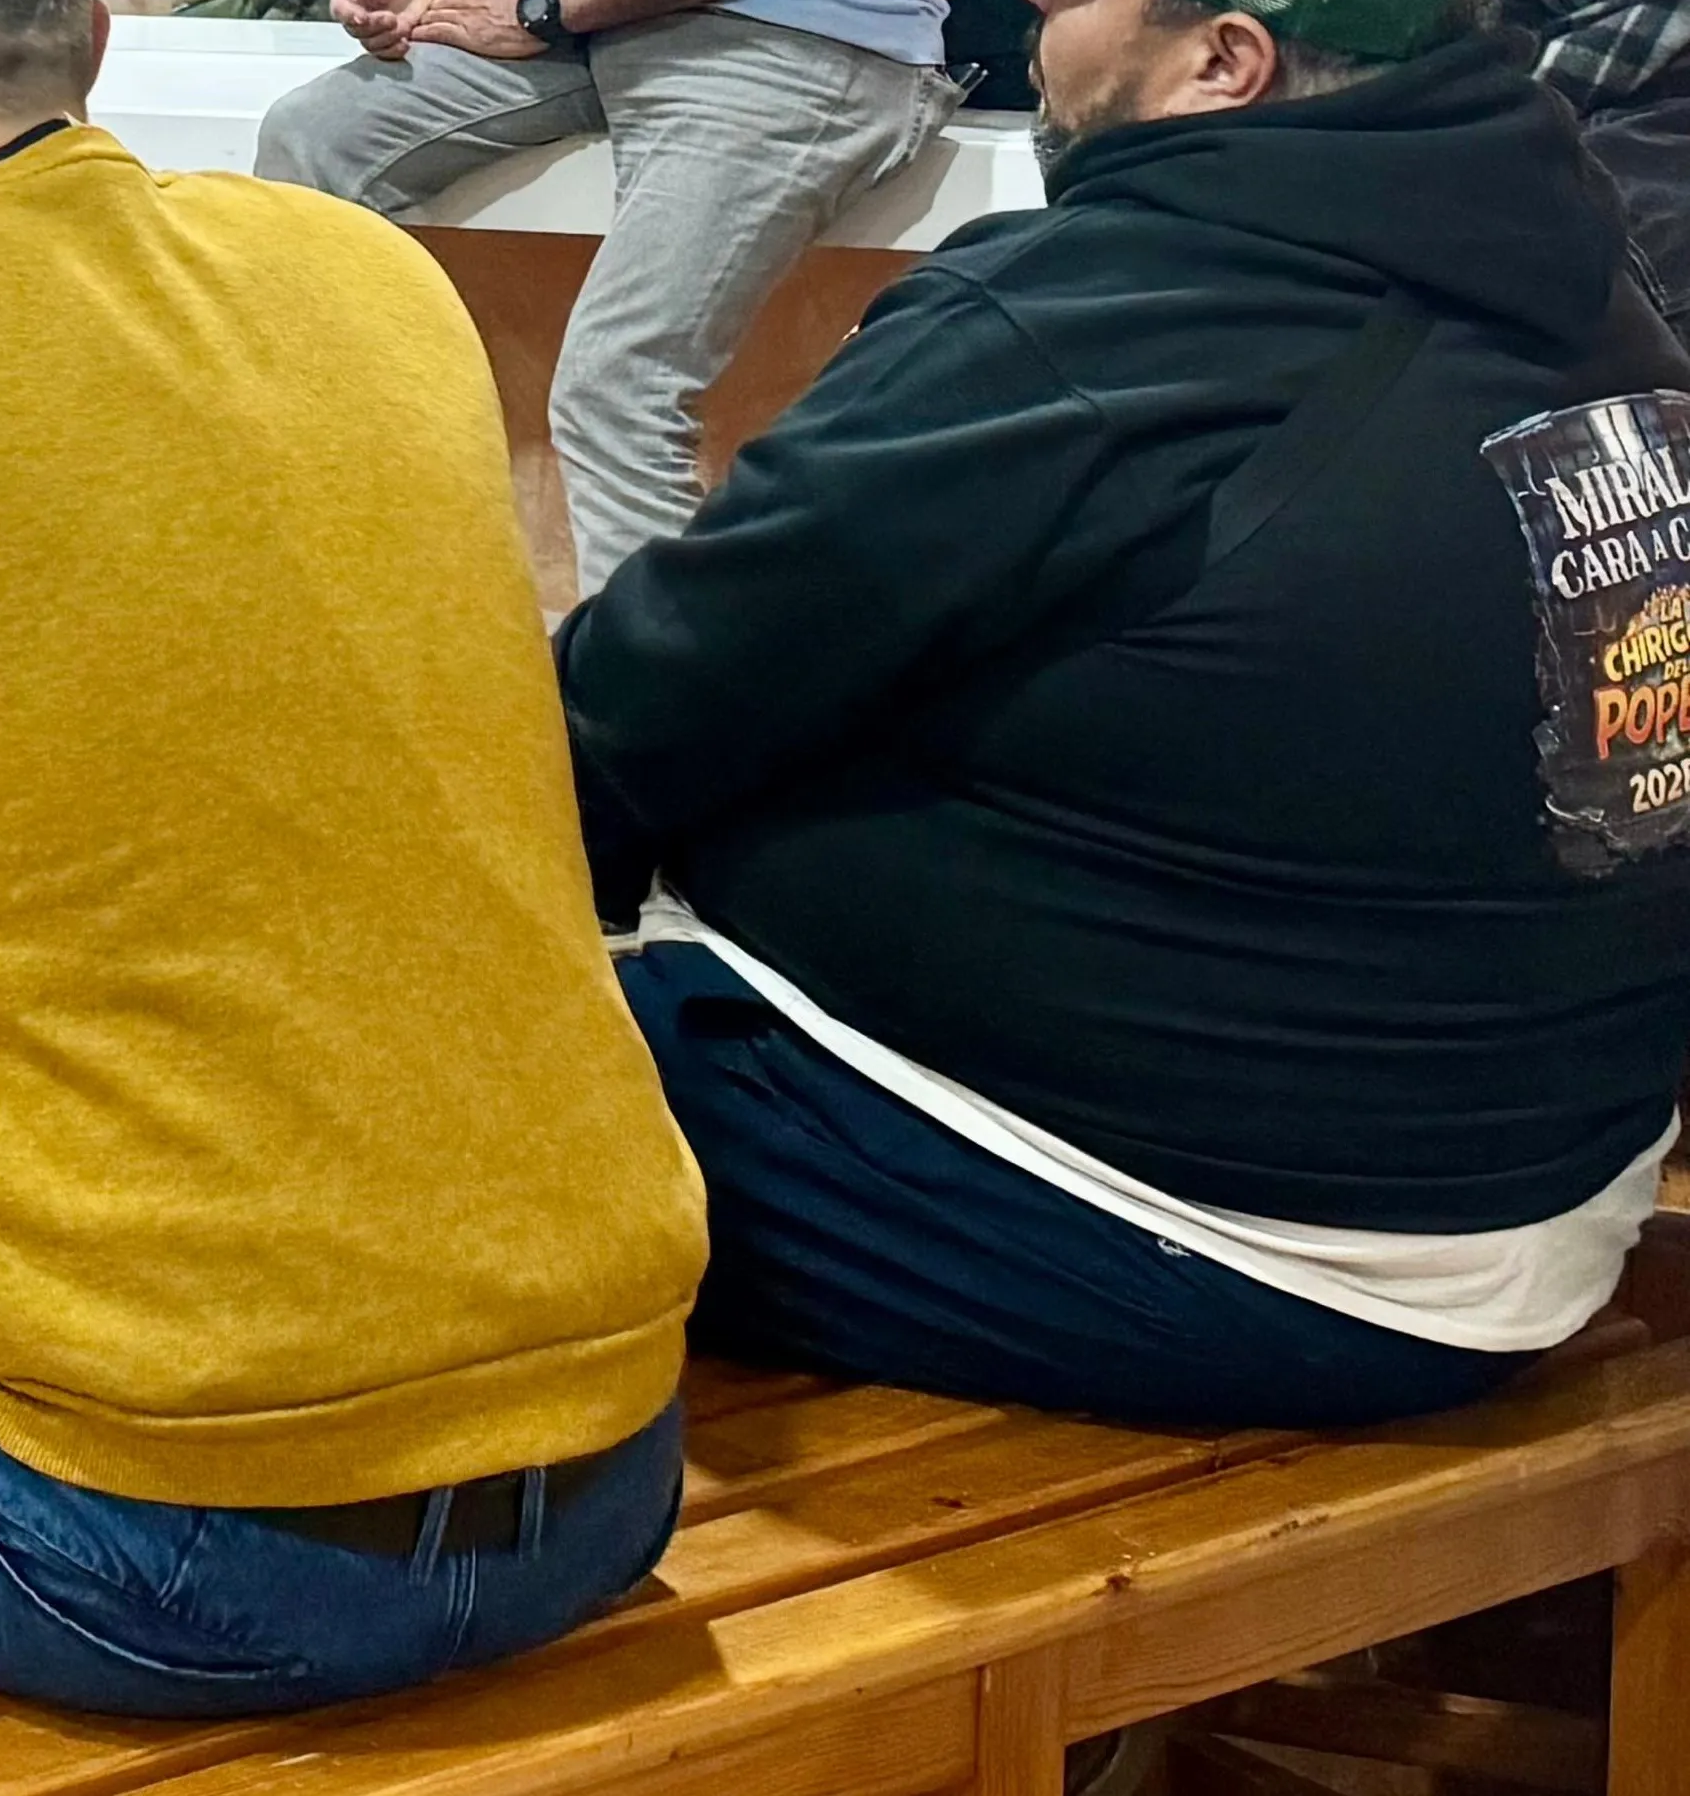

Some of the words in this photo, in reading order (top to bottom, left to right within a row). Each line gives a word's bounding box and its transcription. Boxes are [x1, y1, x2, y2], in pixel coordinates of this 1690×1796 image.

[1551, 529, 1652, 600] CARA
[1651, 528, 1669, 562] A
[1603, 619, 1690, 682] CHIRIG
